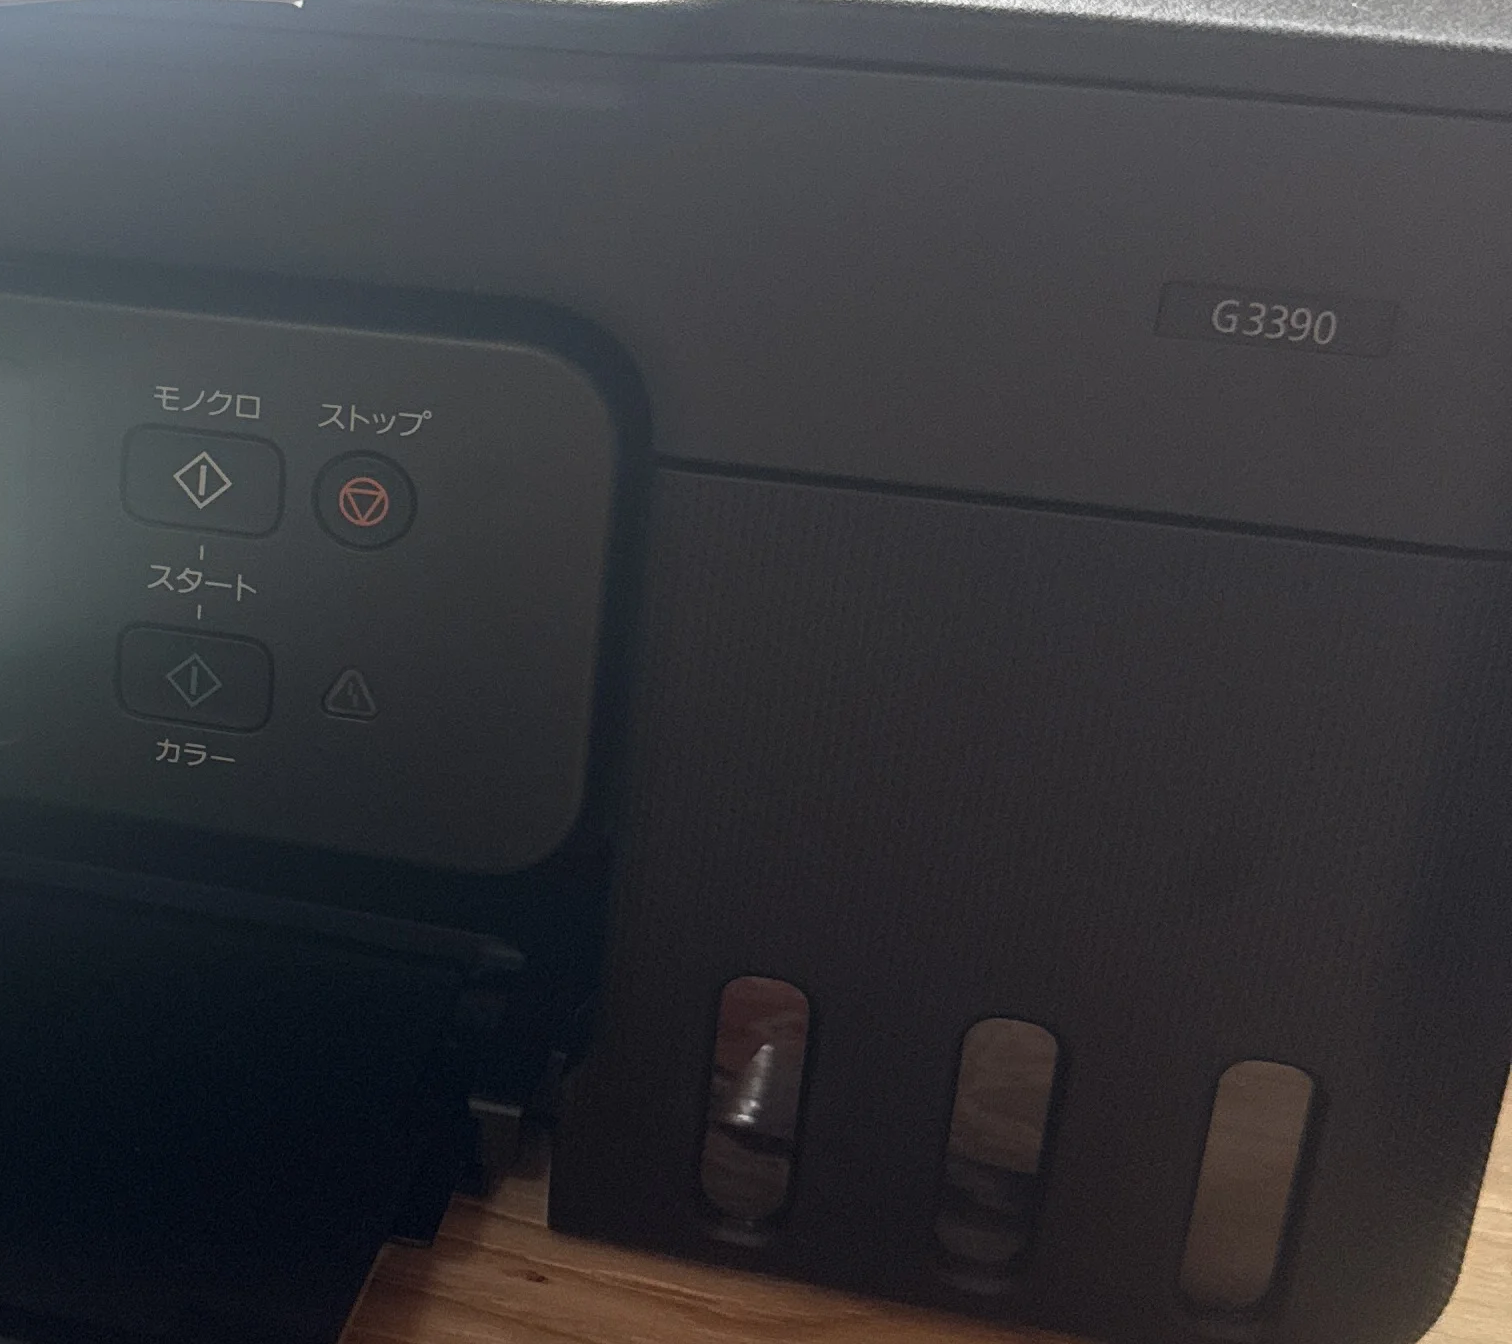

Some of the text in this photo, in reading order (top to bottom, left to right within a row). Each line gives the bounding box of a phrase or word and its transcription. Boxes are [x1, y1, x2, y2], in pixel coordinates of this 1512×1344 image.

[1211, 299, 1337, 345] G3390
[153, 385, 261, 419] モノクロ
[317, 403, 432, 436] ストップ
[146, 564, 257, 601] スタート
[155, 738, 236, 766] カラー
